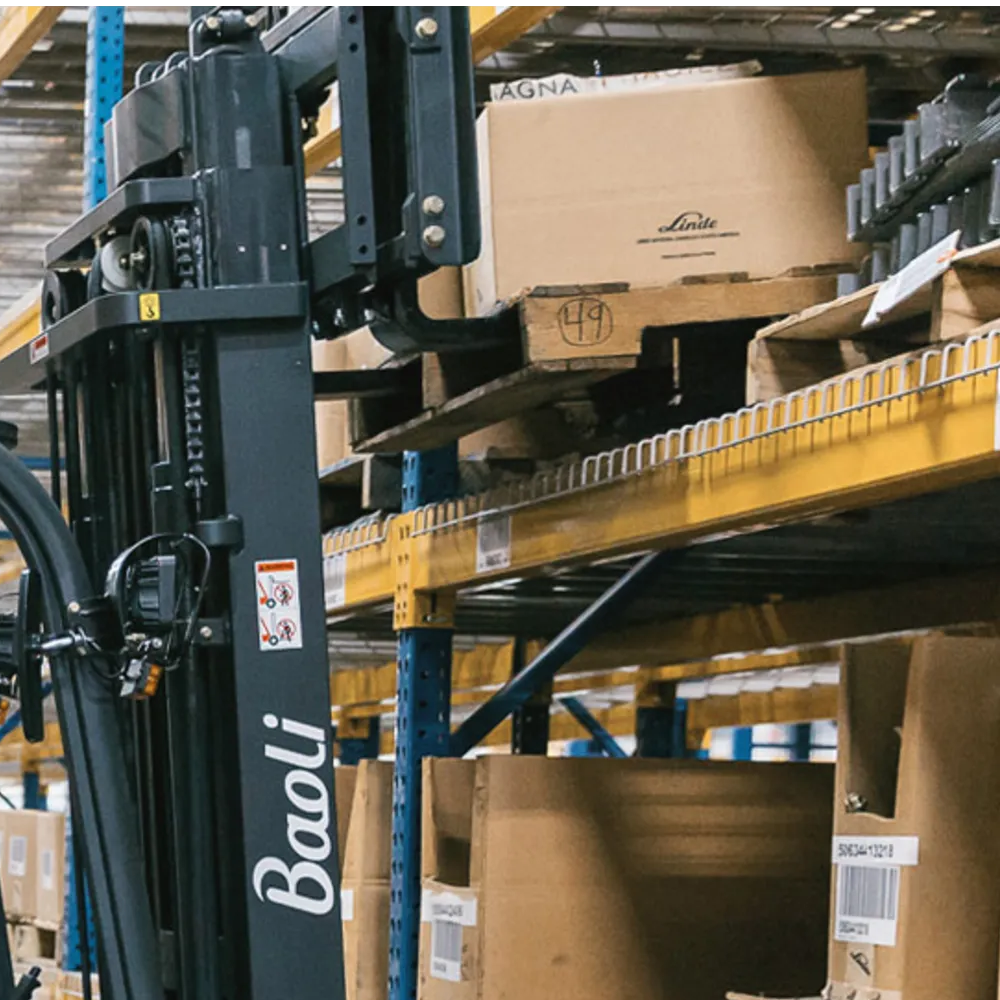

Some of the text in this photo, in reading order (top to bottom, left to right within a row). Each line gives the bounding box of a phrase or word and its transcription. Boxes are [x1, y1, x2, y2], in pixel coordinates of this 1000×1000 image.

[494, 79, 578, 101] AGNA
[658, 210, 718, 233] Linde
[563, 301, 605, 342] 49
[252, 713, 335, 916] Baoli
